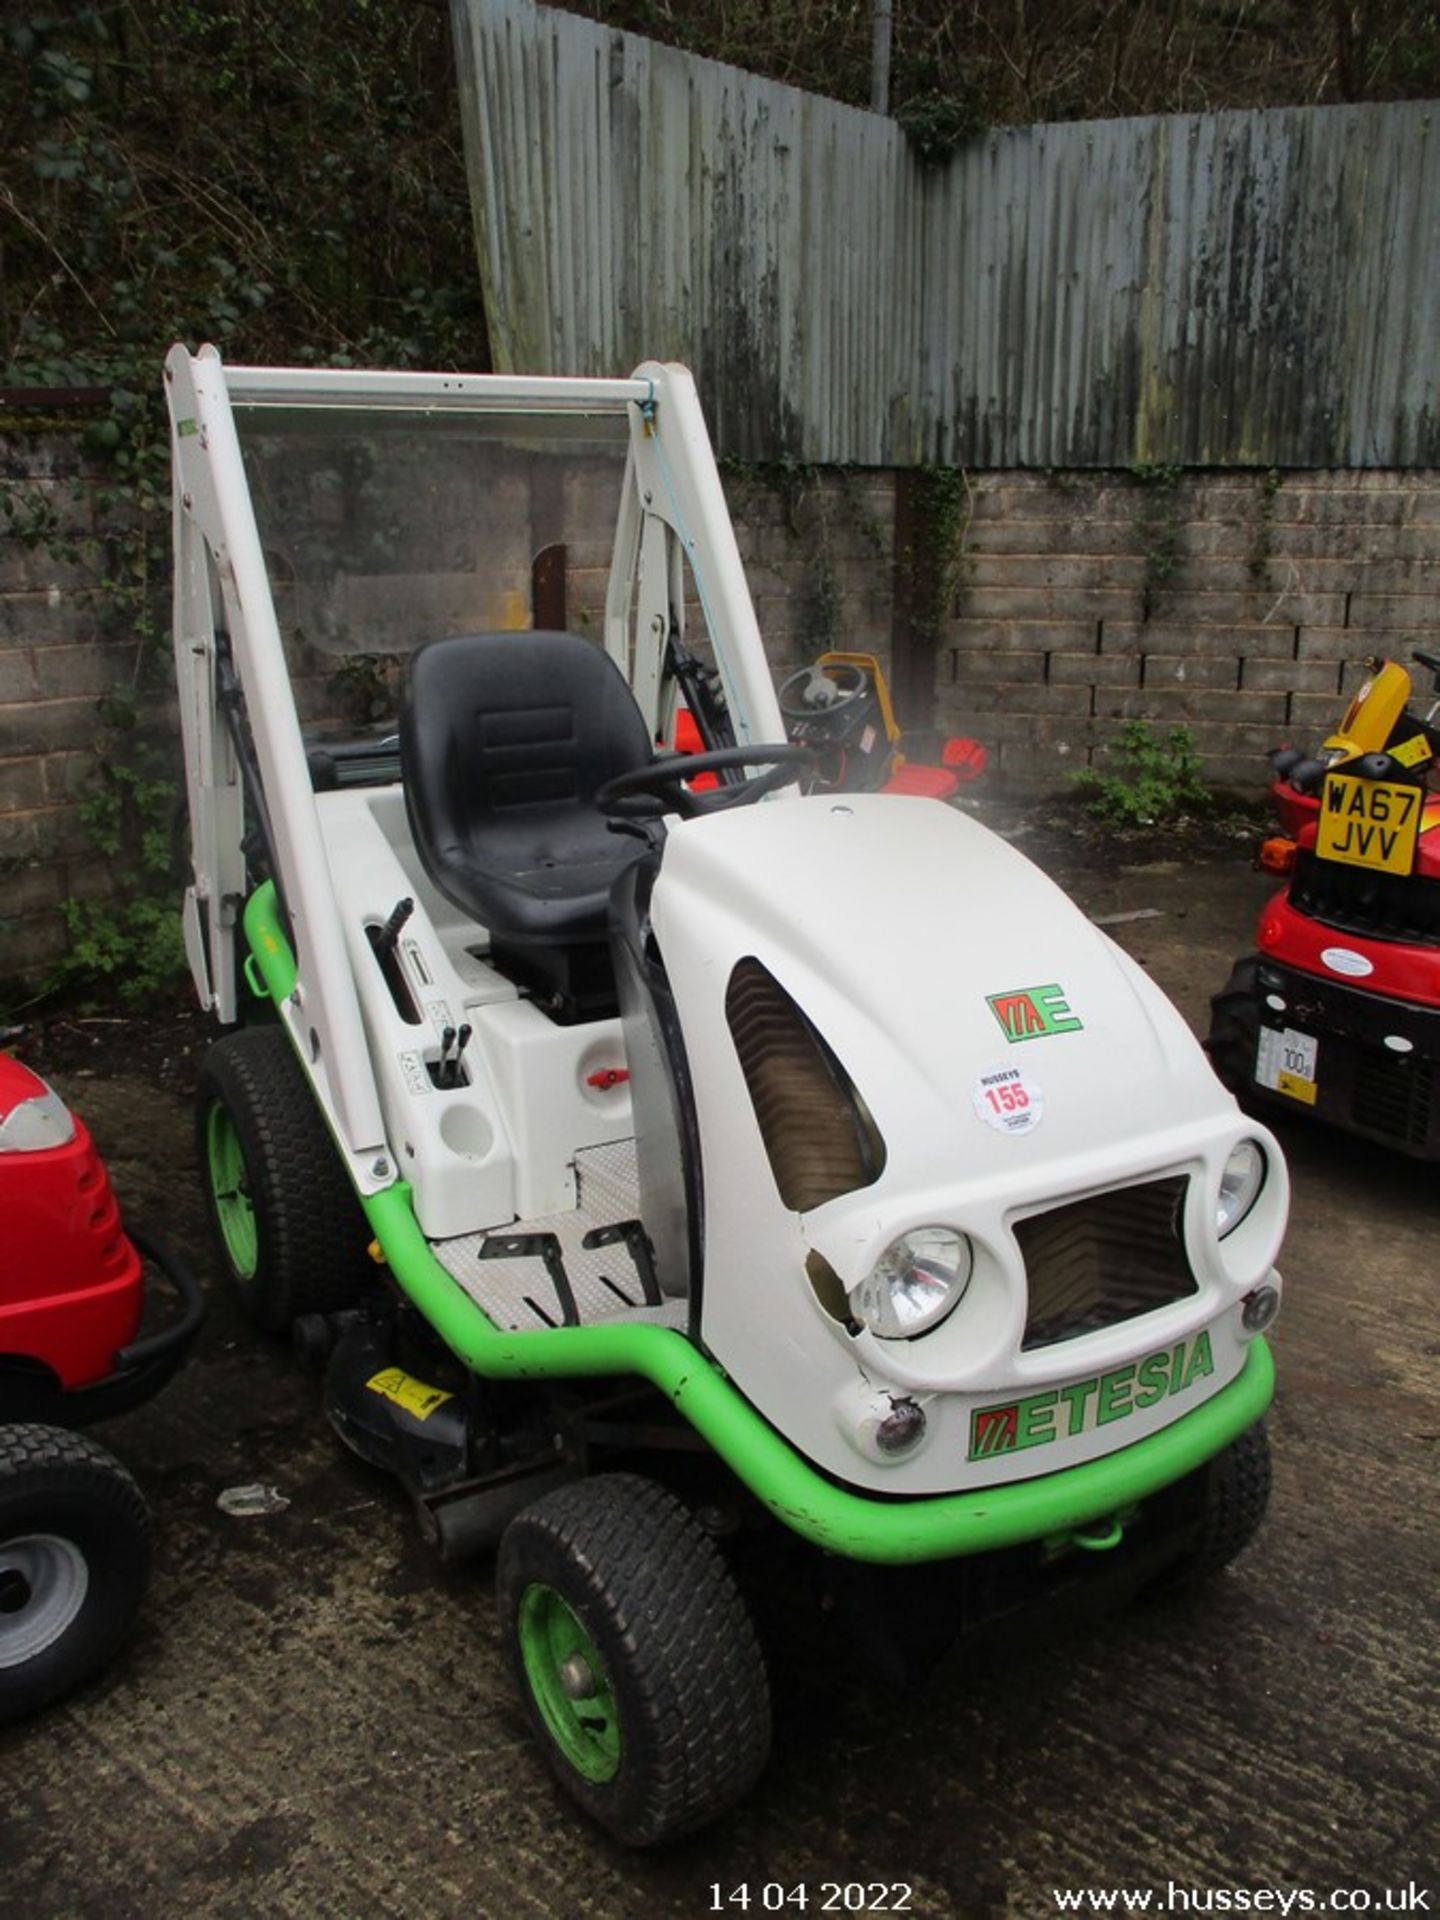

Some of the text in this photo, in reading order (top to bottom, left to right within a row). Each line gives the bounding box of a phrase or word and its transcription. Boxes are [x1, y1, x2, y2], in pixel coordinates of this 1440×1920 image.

[1328, 780, 1416, 826] WA67
[1331, 821, 1399, 860] JVV
[985, 1082, 1030, 1114] 155
[1012, 1328, 1215, 1448] ETESIA
